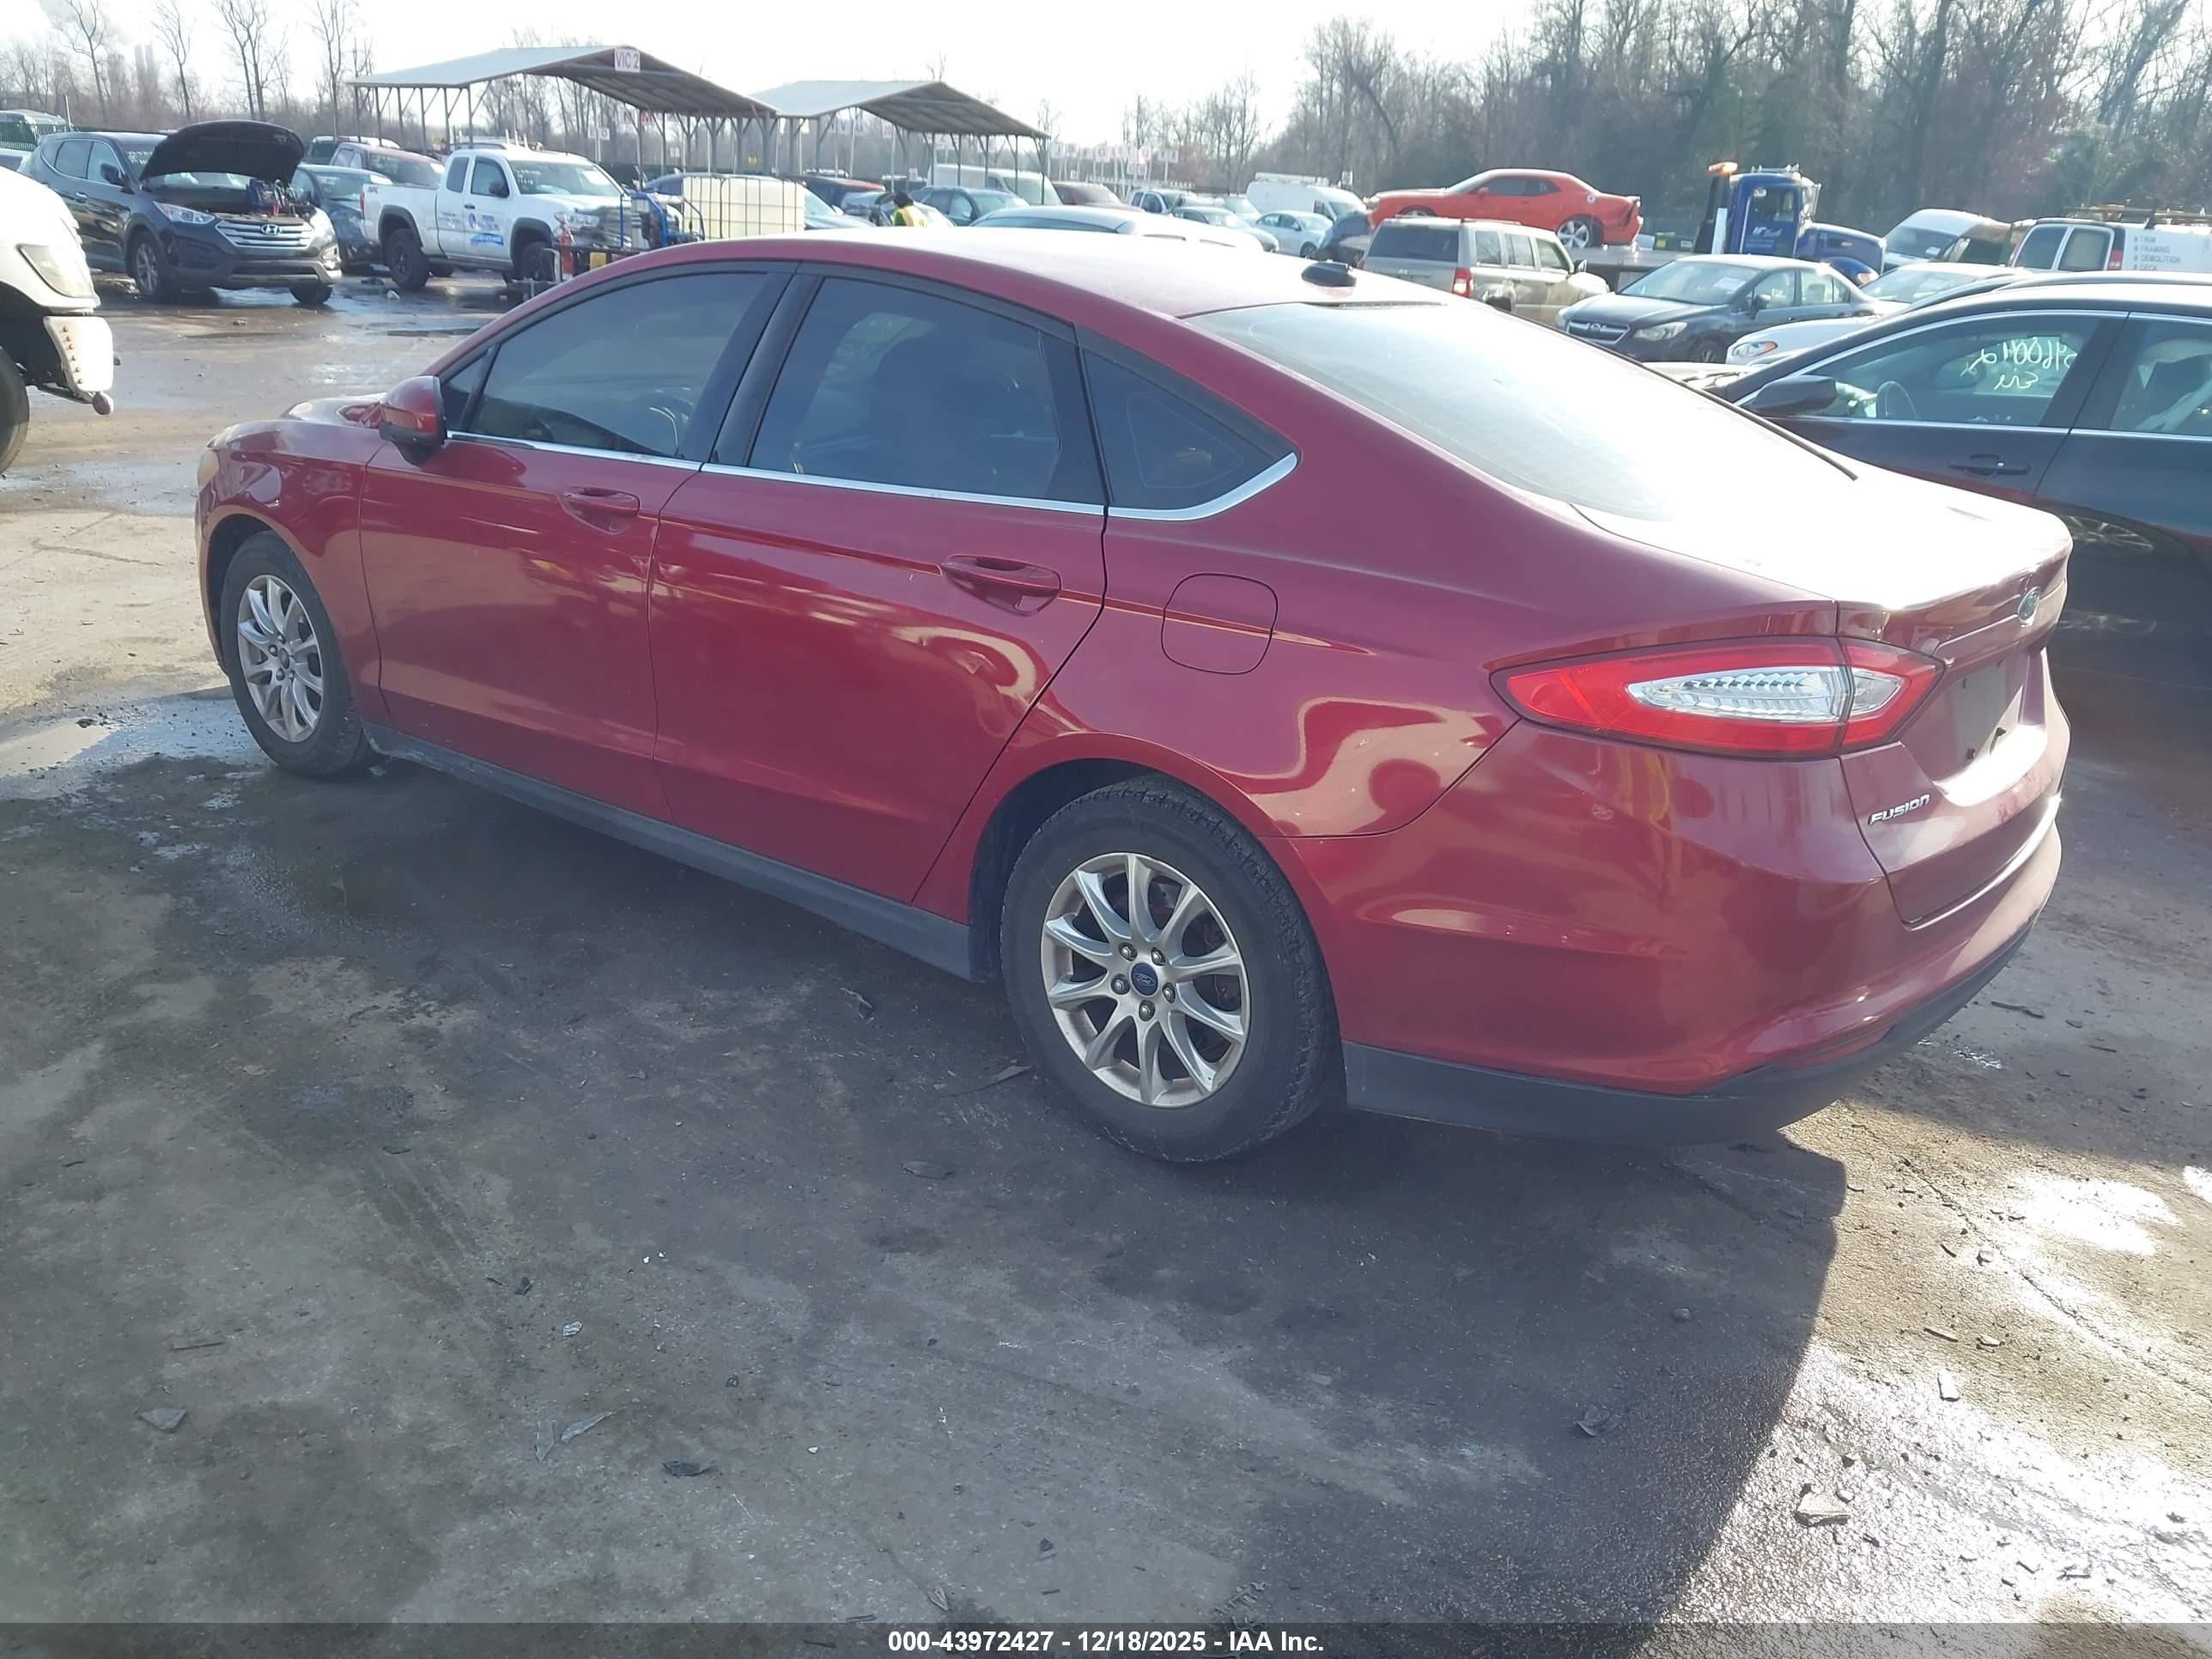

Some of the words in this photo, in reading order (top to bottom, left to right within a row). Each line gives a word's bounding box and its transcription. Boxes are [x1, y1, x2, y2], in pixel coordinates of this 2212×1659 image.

[615, 52, 632, 68] VIC
[633, 53, 640, 70] 2
[2141, 254, 2181, 263] DEMOLITION
[1868, 793, 1930, 824] FUSION
